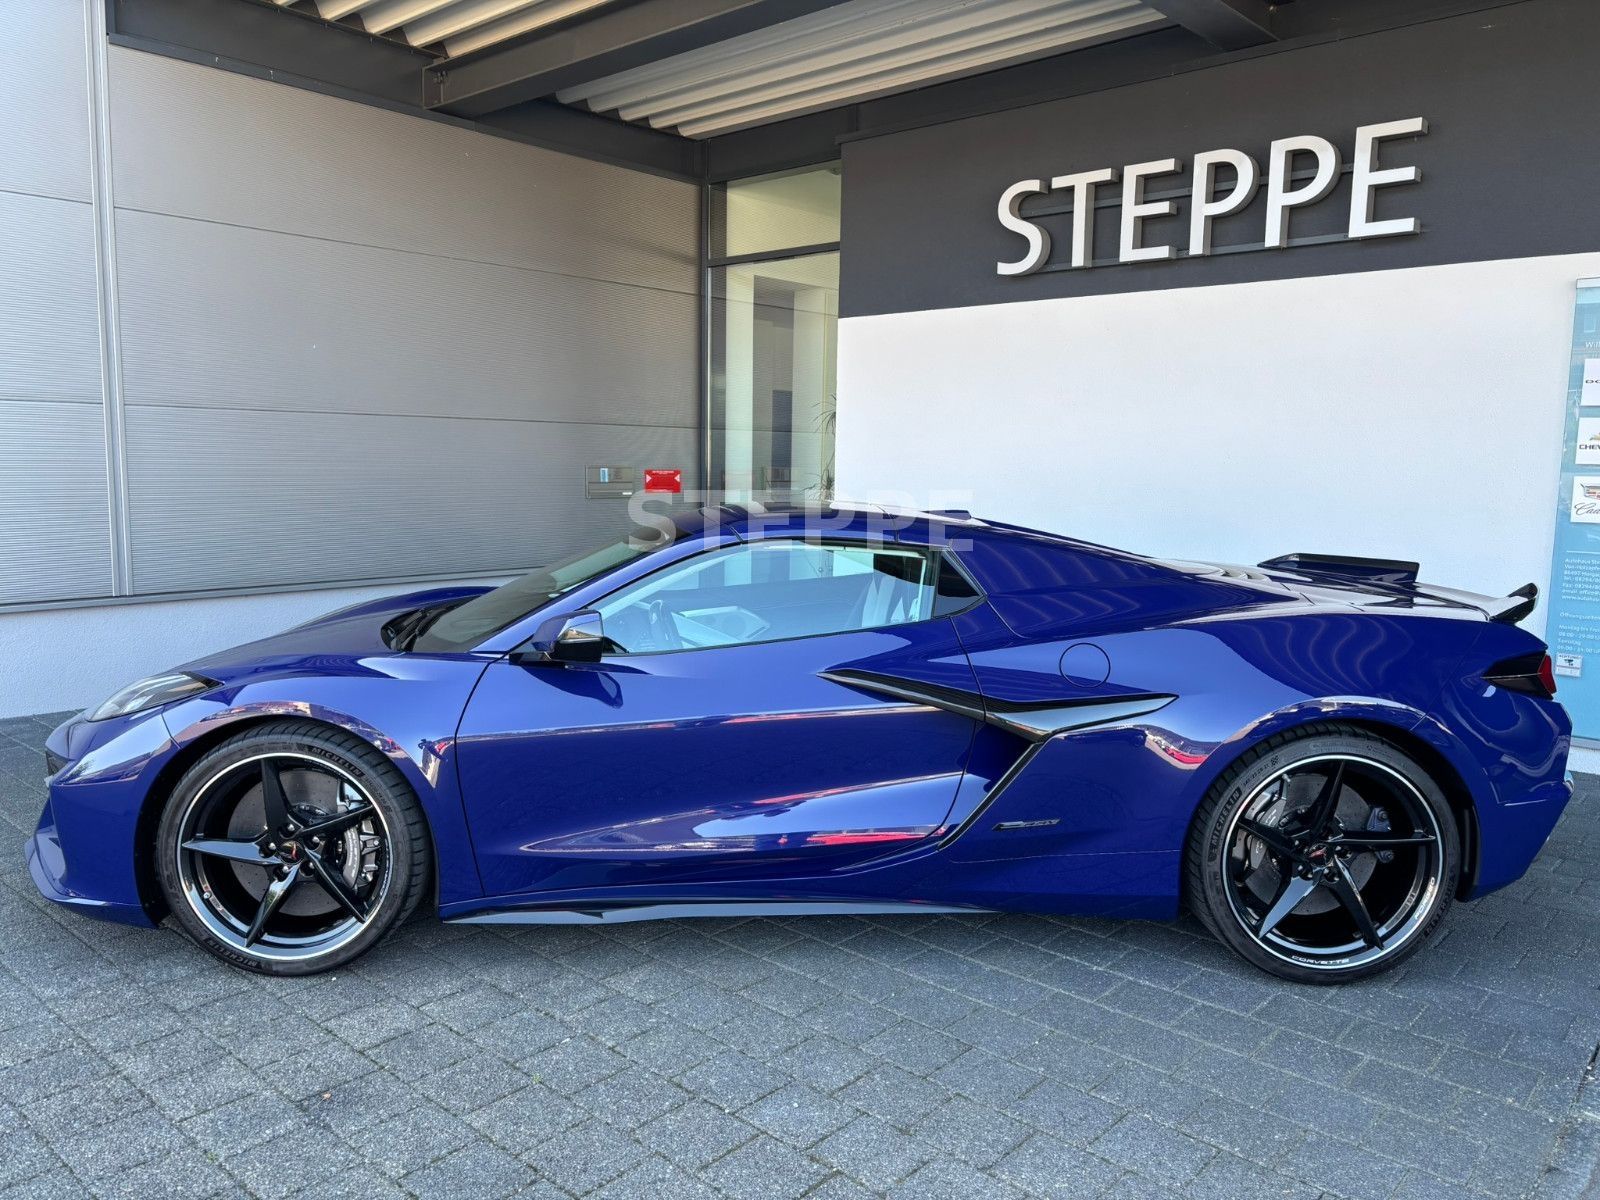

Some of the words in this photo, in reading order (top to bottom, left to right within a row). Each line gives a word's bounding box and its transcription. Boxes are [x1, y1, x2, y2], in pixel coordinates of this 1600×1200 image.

[996, 116, 1429, 277] STEPPE
[311, 747, 363, 776] MICHELIN
[1211, 789, 1241, 846] MICHELIN
